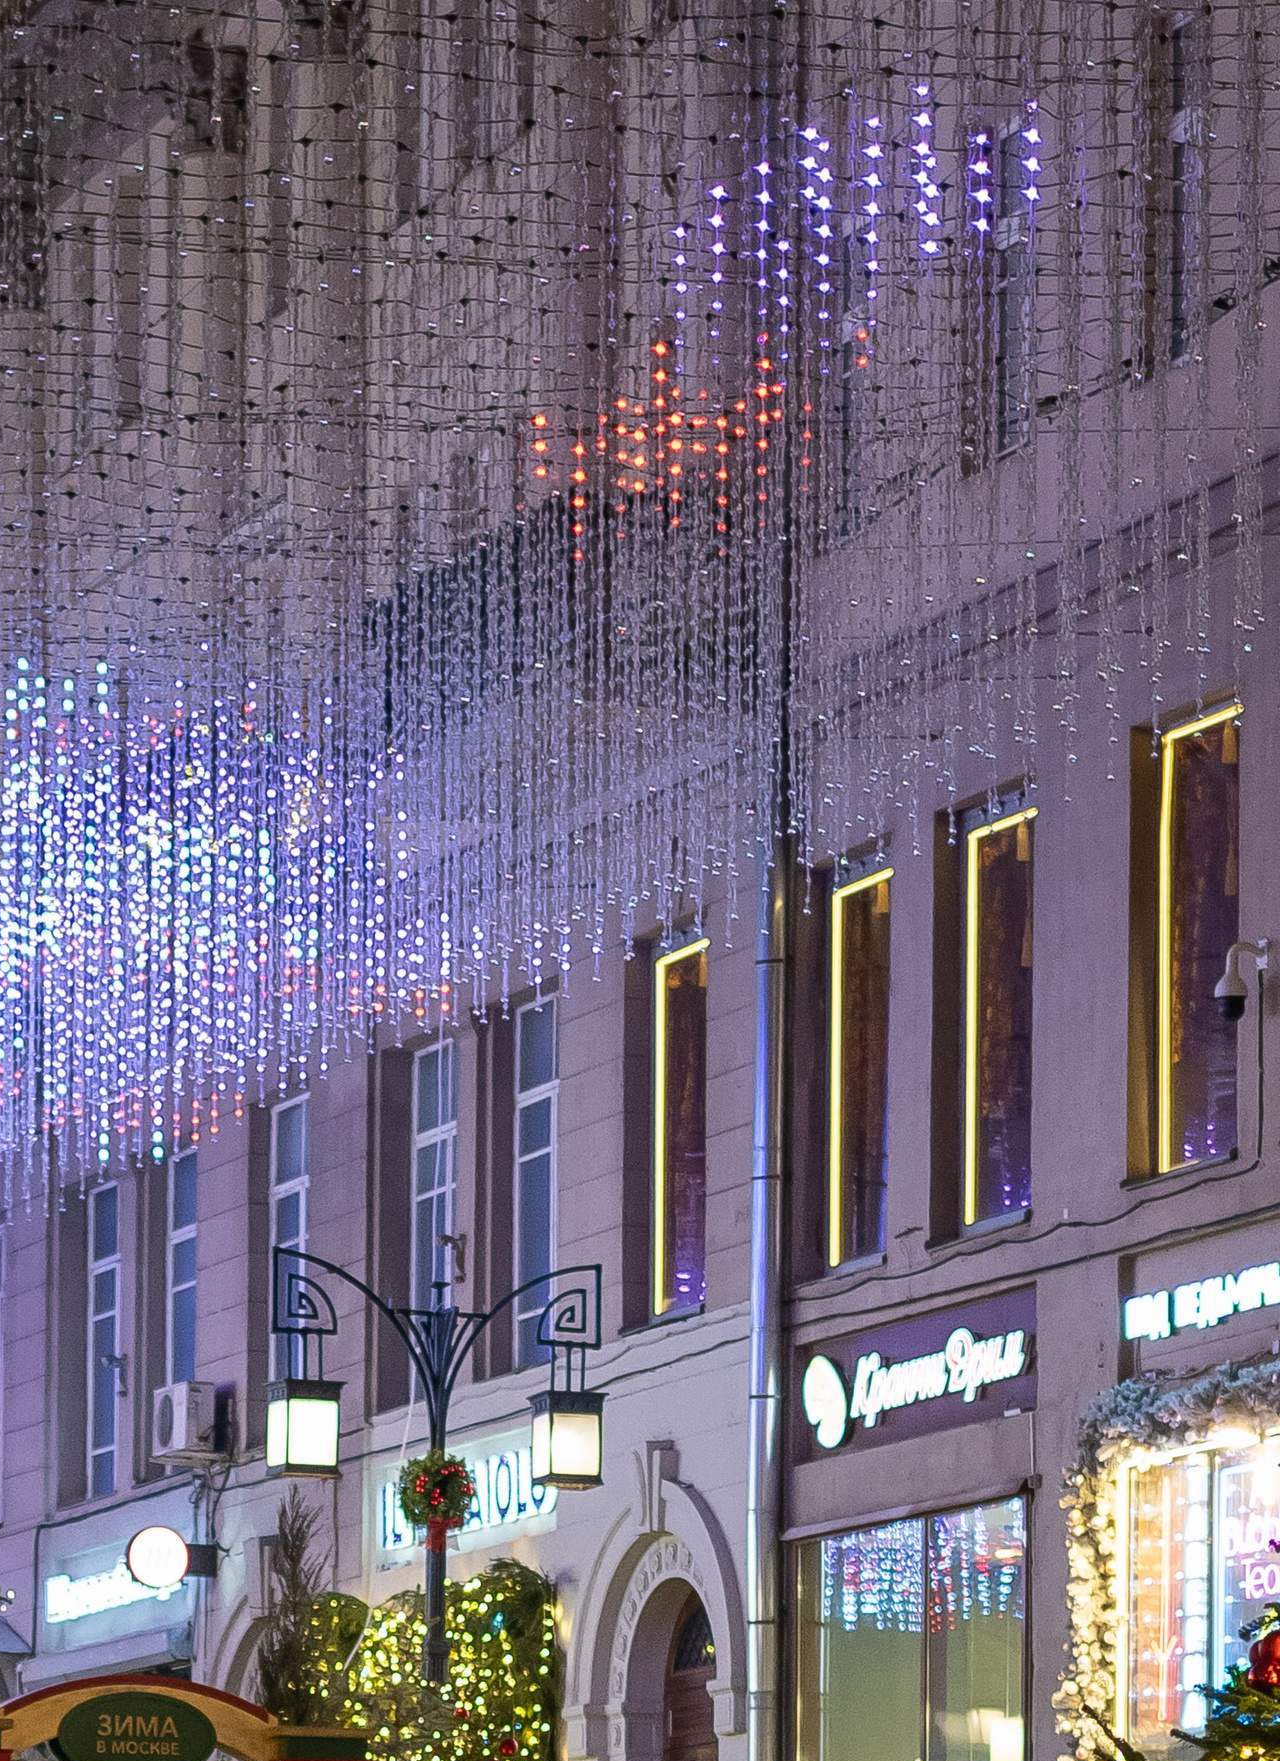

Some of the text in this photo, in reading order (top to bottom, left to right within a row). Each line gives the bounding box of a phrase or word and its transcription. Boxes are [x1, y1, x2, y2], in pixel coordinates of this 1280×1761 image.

[96, 1713, 180, 1739] ЗИМА
[96, 1740, 180, 1756] В МОСКВЕ
